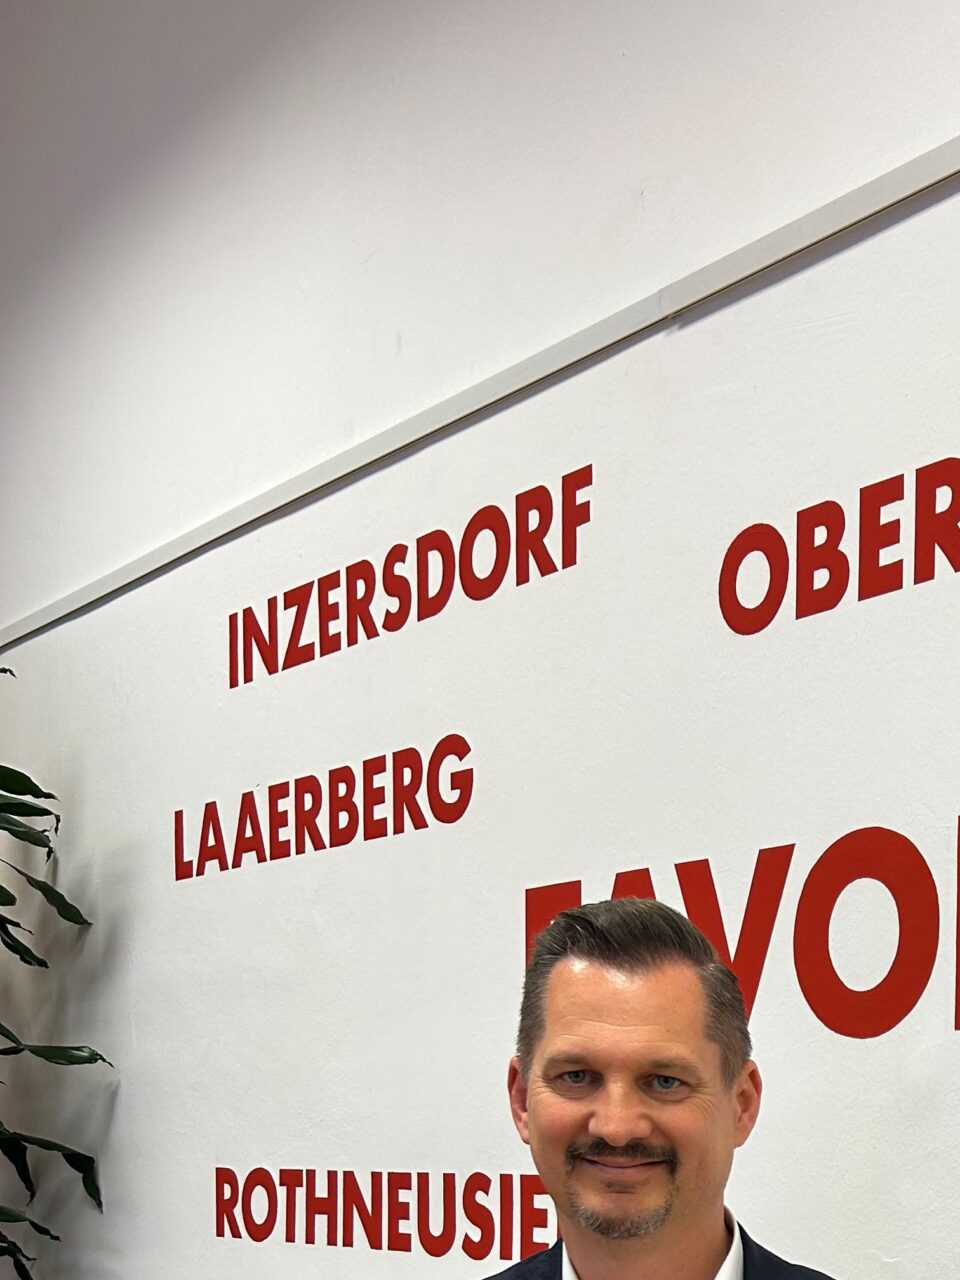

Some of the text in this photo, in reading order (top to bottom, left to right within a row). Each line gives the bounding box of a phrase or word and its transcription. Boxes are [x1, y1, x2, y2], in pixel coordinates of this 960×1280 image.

[229, 464, 593, 689] INZERSDORF
[175, 734, 474, 881] LAAERBERG
[216, 1167, 561, 1261] ROTHNEUSIE
